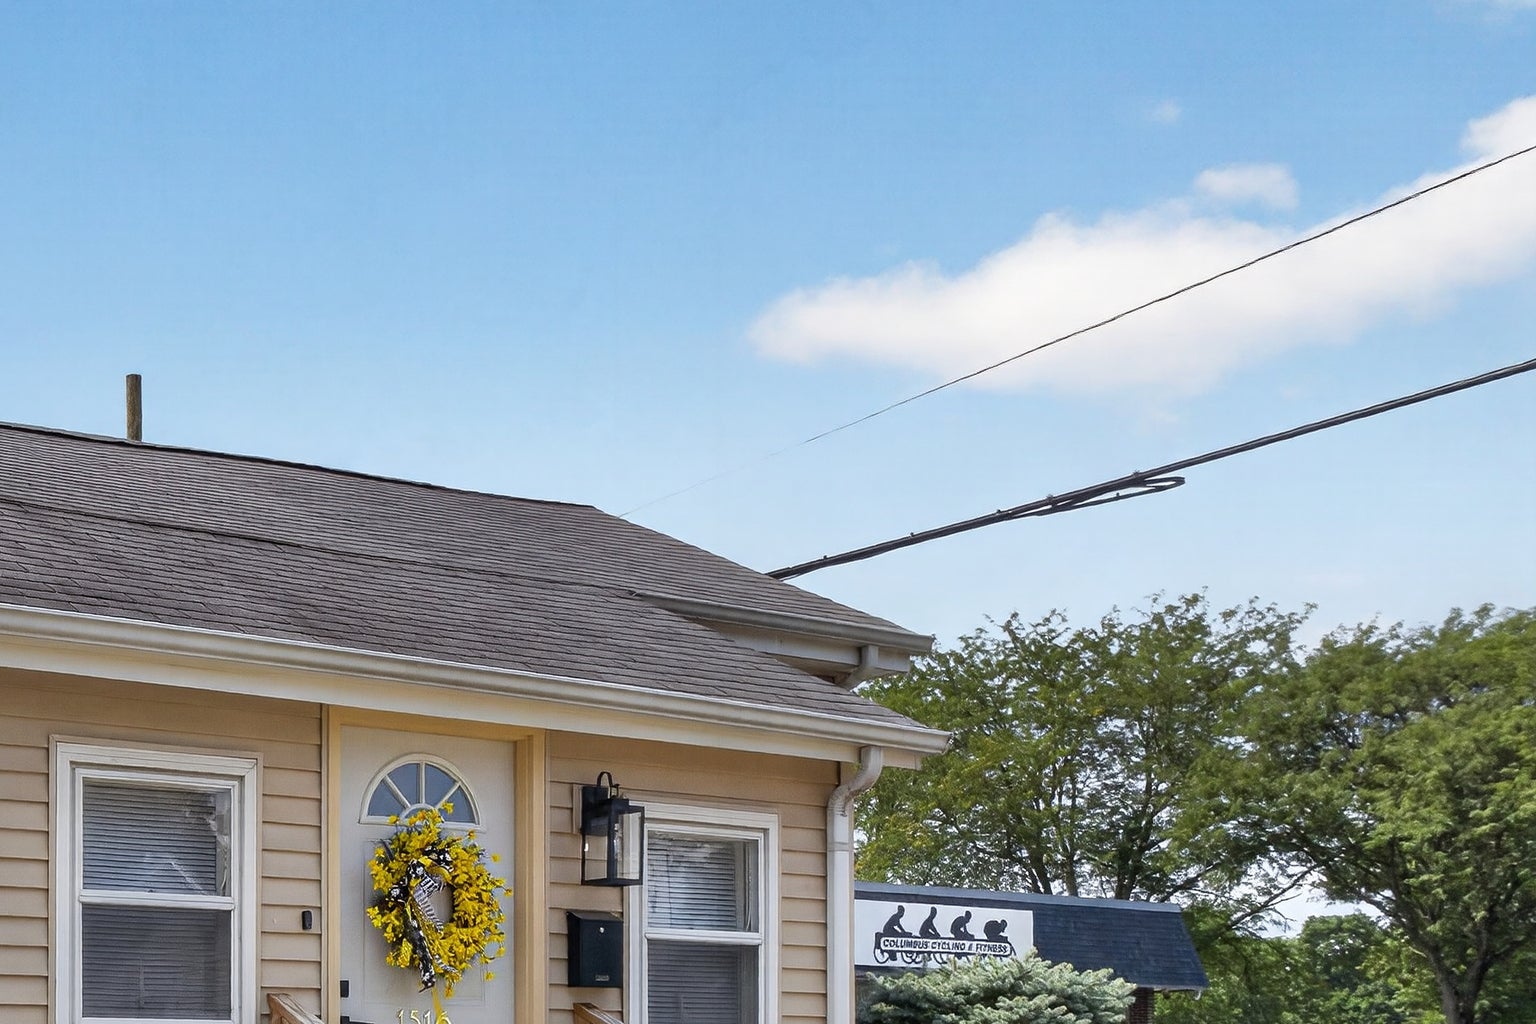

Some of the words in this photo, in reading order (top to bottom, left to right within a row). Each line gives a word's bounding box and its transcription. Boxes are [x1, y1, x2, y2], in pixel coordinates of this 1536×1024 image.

[883, 938, 928, 950] COLUMBUS
[930, 940, 966, 951] CYCLING
[975, 943, 1008, 954] FITNESS
